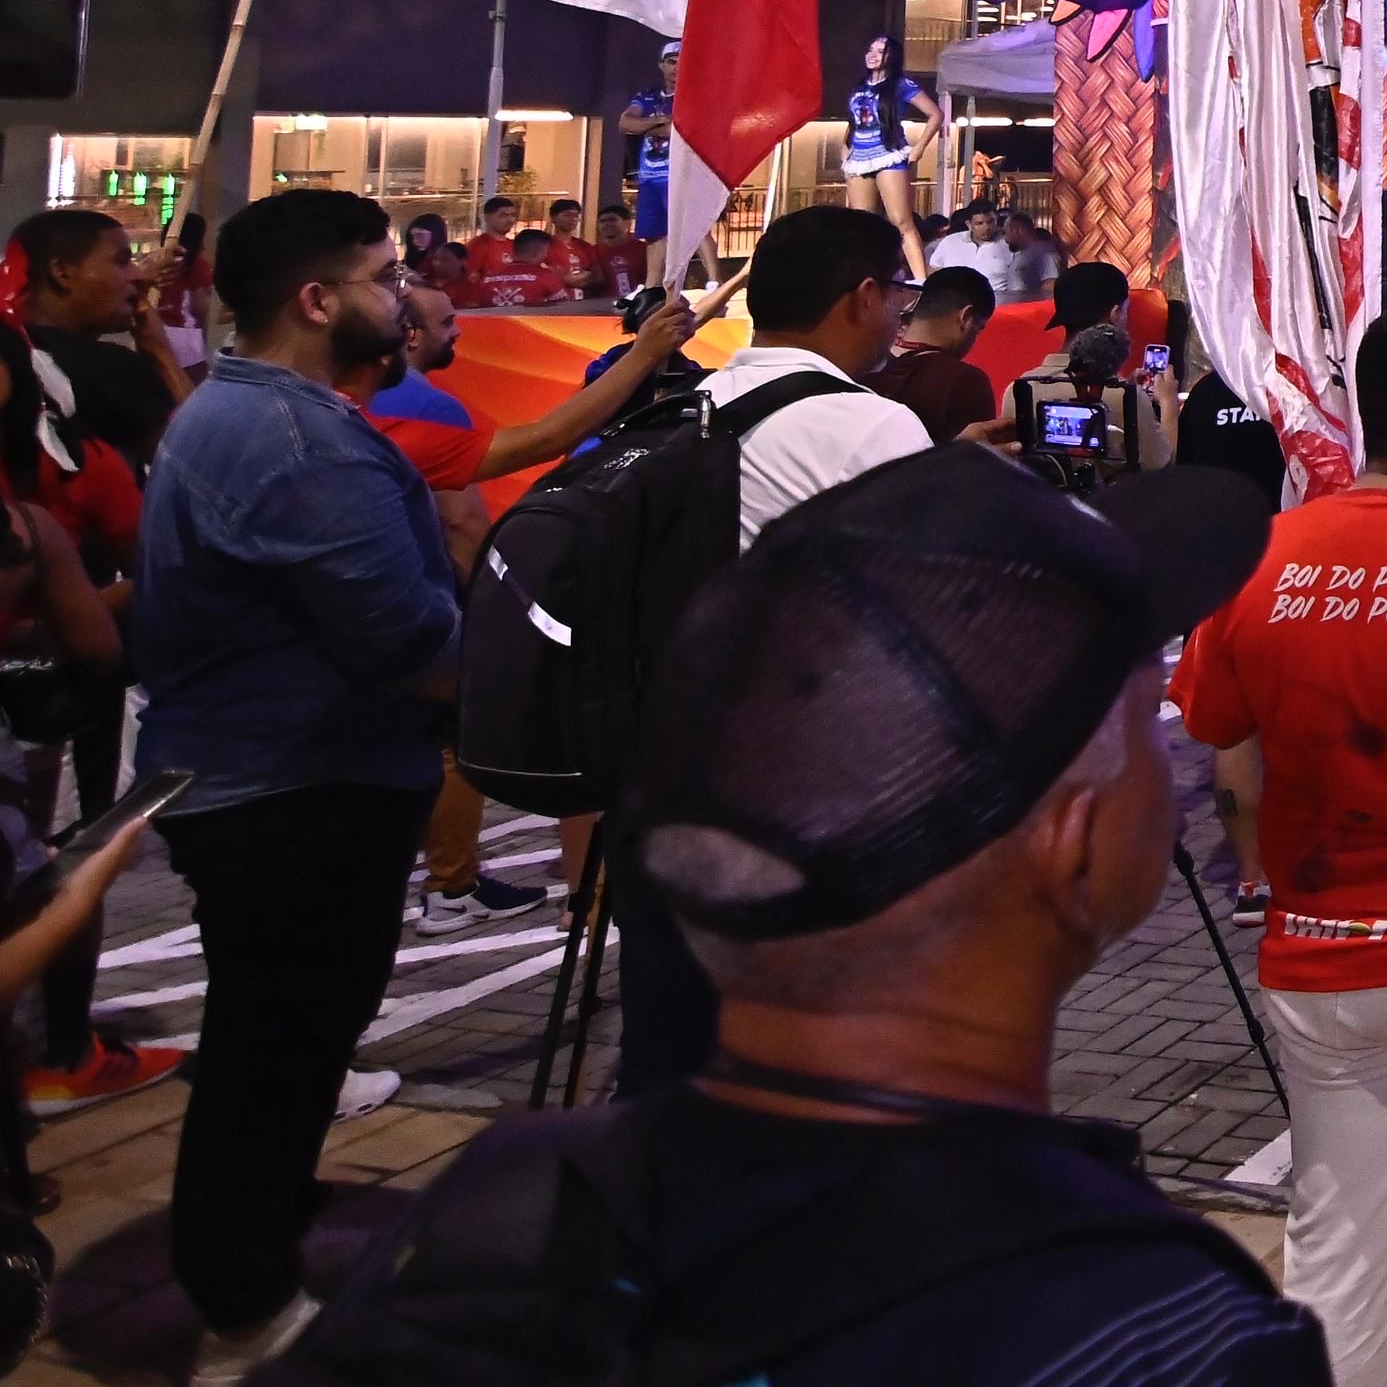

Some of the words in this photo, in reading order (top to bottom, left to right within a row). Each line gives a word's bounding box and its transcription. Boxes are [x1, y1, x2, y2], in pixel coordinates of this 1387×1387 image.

[1273, 562, 1323, 593] BOI
[1326, 565, 1367, 592] DO
[1267, 593, 1316, 624] BOI
[1319, 595, 1360, 622] DO
